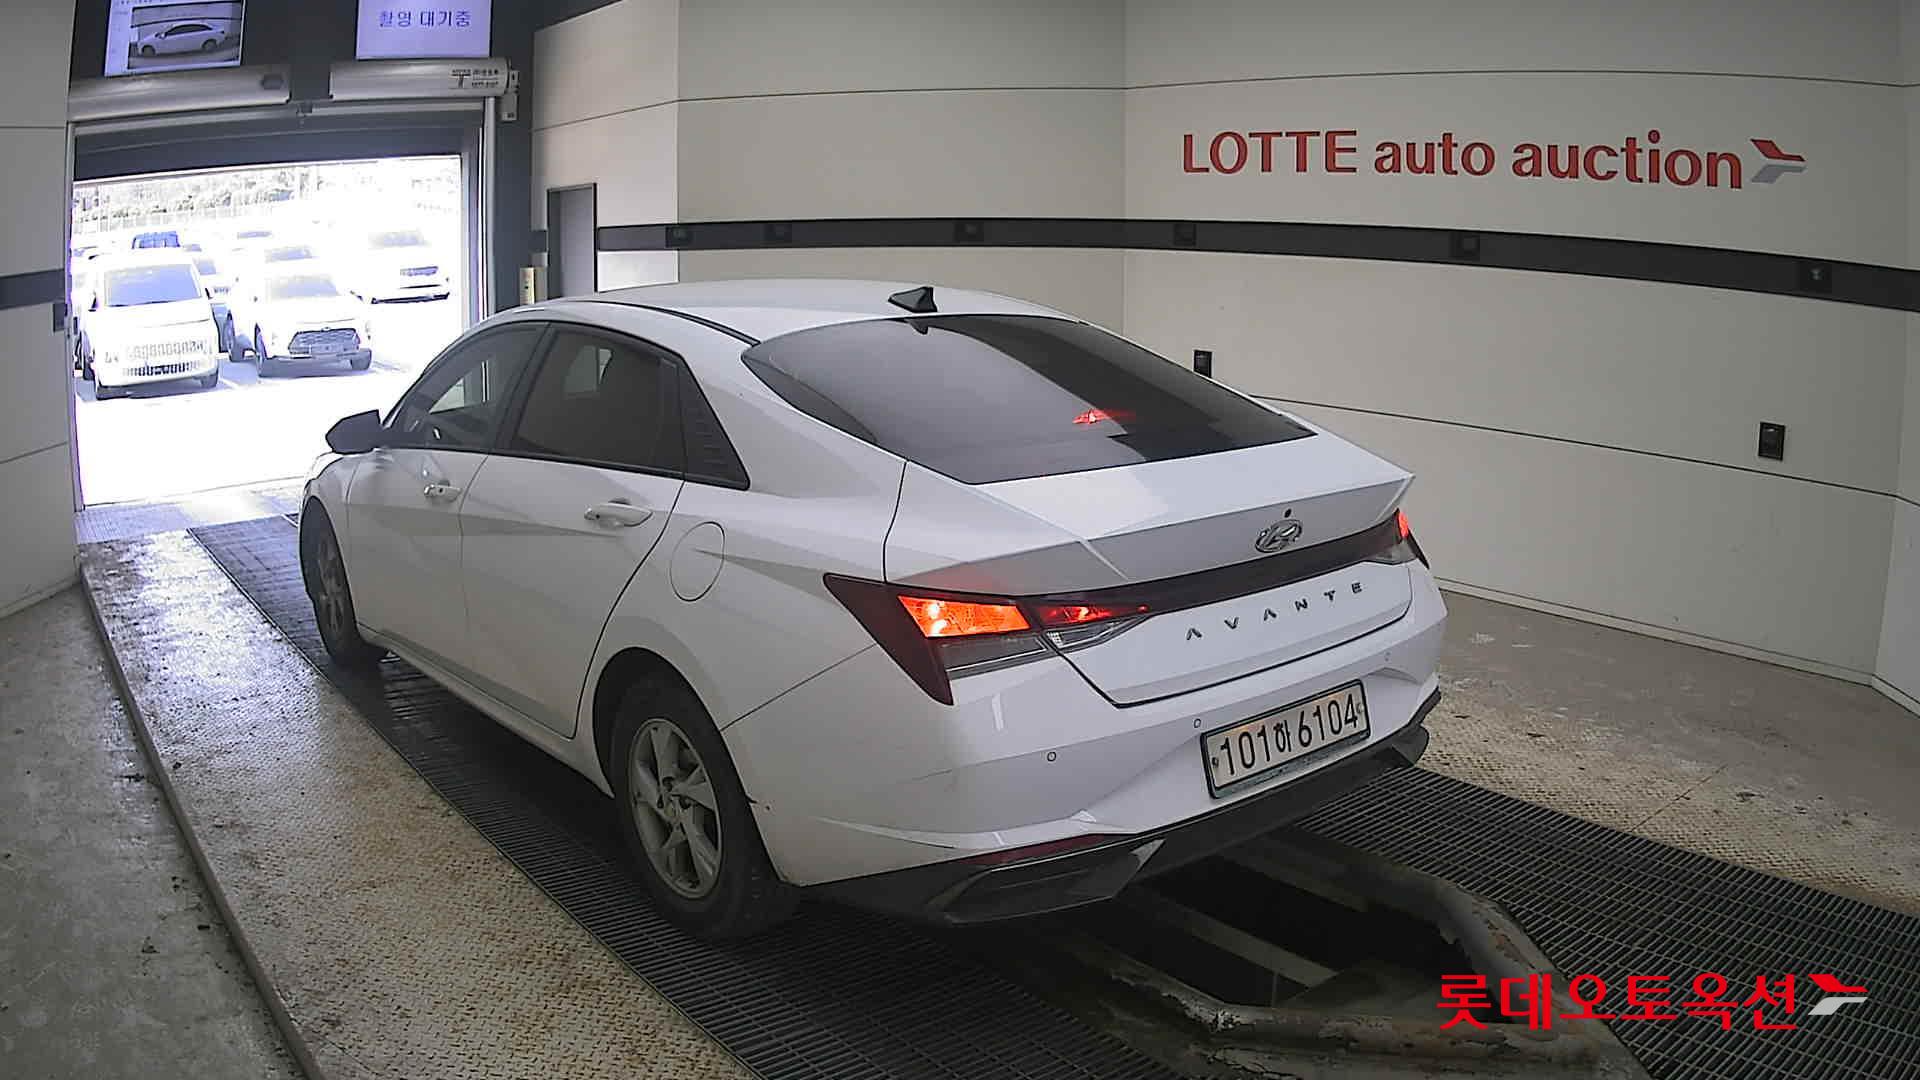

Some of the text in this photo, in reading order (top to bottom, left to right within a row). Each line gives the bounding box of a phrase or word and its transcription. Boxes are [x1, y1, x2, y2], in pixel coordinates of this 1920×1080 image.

[420, 10, 471, 27] 대기중
[1184, 129, 1743, 189] LOTTE auto auction
[1187, 582, 1363, 640] AVANTE
